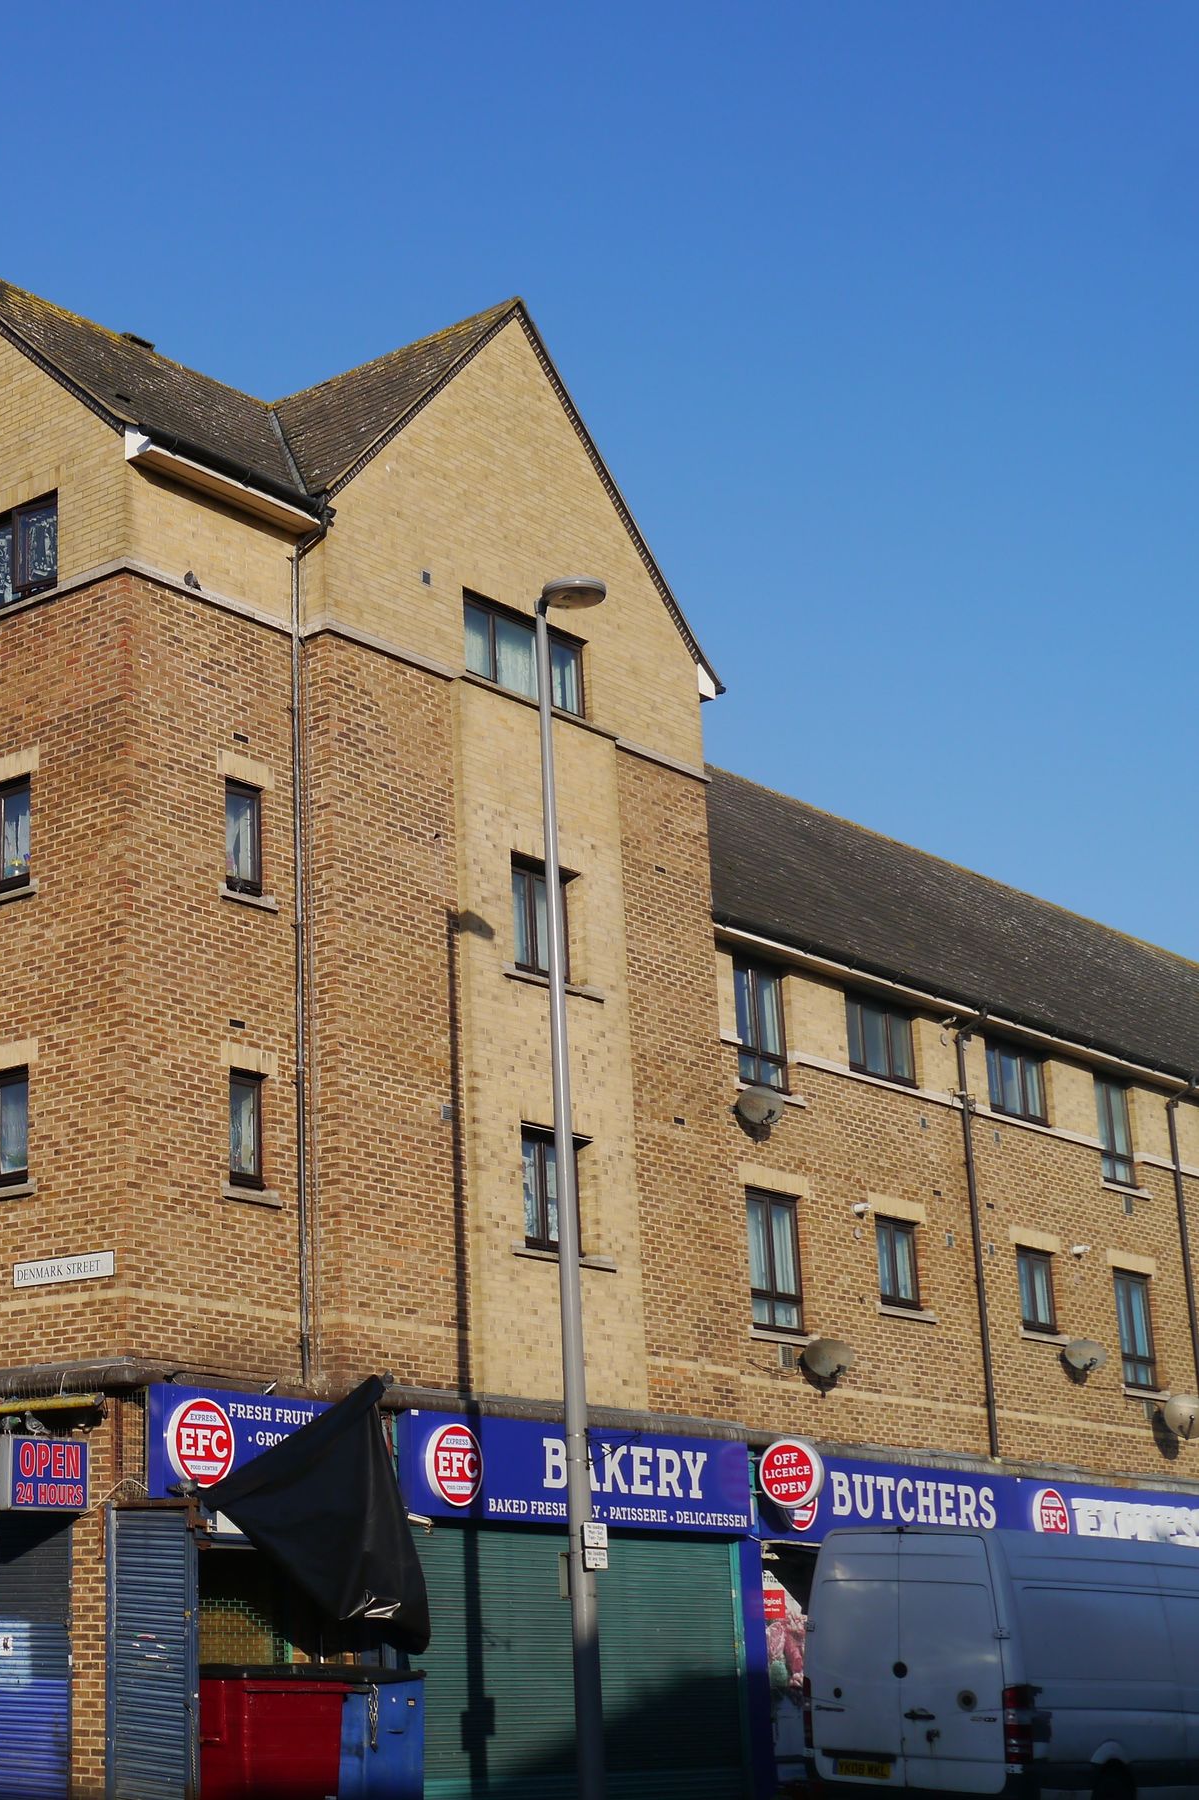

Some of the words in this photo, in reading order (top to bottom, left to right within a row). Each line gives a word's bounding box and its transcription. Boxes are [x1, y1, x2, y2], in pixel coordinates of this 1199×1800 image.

[17, 1264, 63, 1281] DENMARK
[66, 1259, 101, 1275] STREET
[190, 1413, 217, 1423] EXPRESS
[228, 1402, 272, 1422] FRESH
[275, 1408, 314, 1426] FRUIT
[179, 1427, 228, 1458] EFC
[445, 1437, 469, 1446] EXPRESS
[19, 1441, 81, 1479] OPEN
[436, 1451, 478, 1479] EFC
[773, 1452, 798, 1466] OFF
[764, 1465, 811, 1479] LICENCE
[16, 1482, 34, 1504] 24
[37, 1483, 84, 1506] HOURS
[771, 1481, 807, 1495] OPEN
[830, 1471, 997, 1529] BUTCHERS
[488, 1498, 528, 1514] BAKED
[530, 1500, 568, 1517] FRESH
[609, 1506, 668, 1524] PATISSERIE
[676, 1510, 748, 1528] DELICATESSEN
[1041, 1509, 1067, 1530] EFC
